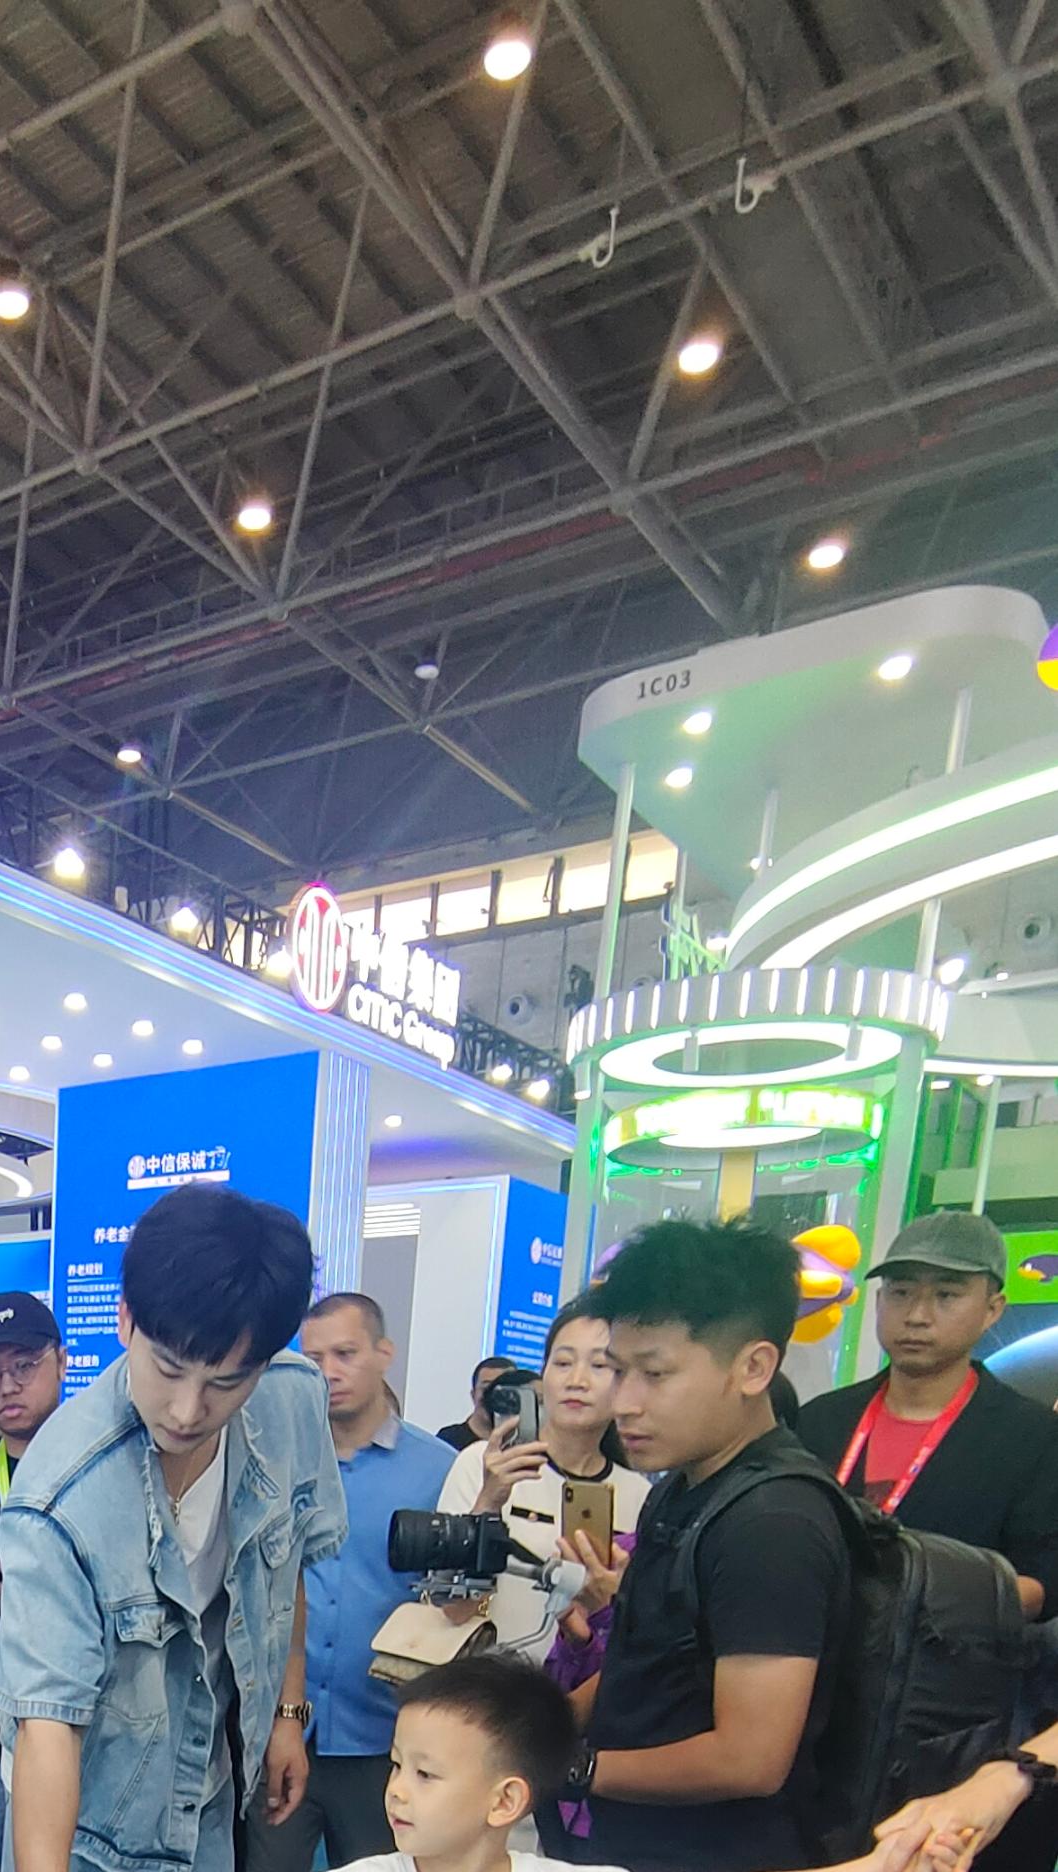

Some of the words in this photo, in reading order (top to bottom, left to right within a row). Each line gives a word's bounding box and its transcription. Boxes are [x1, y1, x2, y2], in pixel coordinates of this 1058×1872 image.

[638, 669, 691, 699] 1C03
[347, 983, 403, 1039] CITIC
[146, 1149, 207, 1176] 中信保诚
[94, 1224, 134, 1244] 养老金
